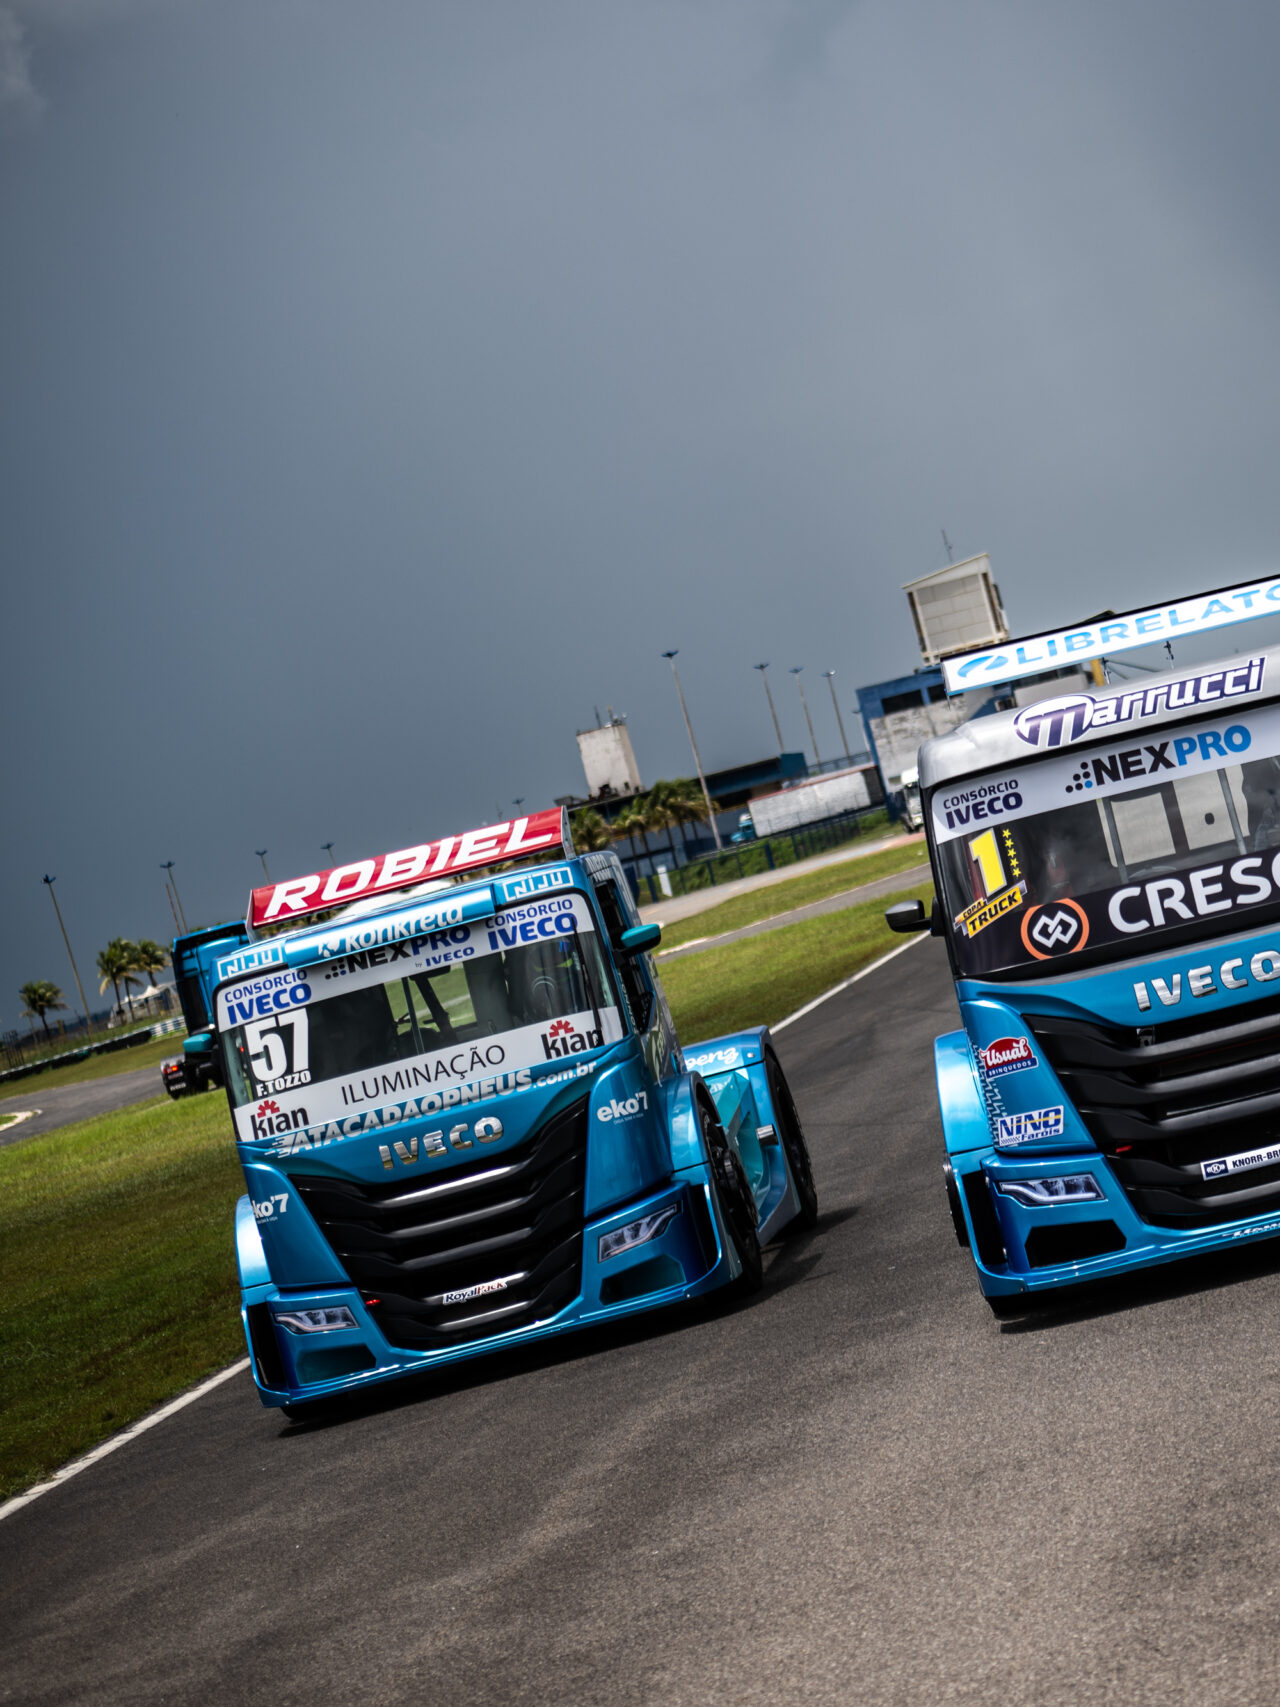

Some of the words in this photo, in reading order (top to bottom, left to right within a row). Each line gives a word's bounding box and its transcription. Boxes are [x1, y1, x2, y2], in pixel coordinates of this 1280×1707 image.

[1014, 655, 1267, 747] Marrucci
[1091, 724, 1252, 786] NEXPRO
[943, 779, 1019, 810] CONSÓRCIO
[945, 792, 1023, 830] IVECO
[264, 817, 553, 918] ROBIEL
[968, 828, 1007, 898] 1
[485, 898, 574, 929] CONSÓRCIO
[962, 900, 983, 918] COPA
[969, 890, 1019, 934] TRUCK
[488, 912, 578, 950] IVECO
[343, 925, 471, 974] NEXPRO
[426, 946, 475, 967] IVECO
[224, 969, 308, 1003] CONSÓRCIO
[227, 983, 312, 1025] IVECO
[244, 1007, 309, 1082] 57
[541, 1029, 605, 1061] kian
[981, 1038, 1029, 1066] Usual
[256, 1070, 312, 1097] F.TOZZO
[341, 1045, 505, 1105] ILUMINAÇÃO
[988, 1060, 1032, 1076] BRINQUEDOS
[250, 1107, 310, 1140] kian
[379, 1116, 505, 1170] IVECO
[252, 1193, 289, 1219] ko'7
[446, 1282, 504, 1302] RoyalPack
